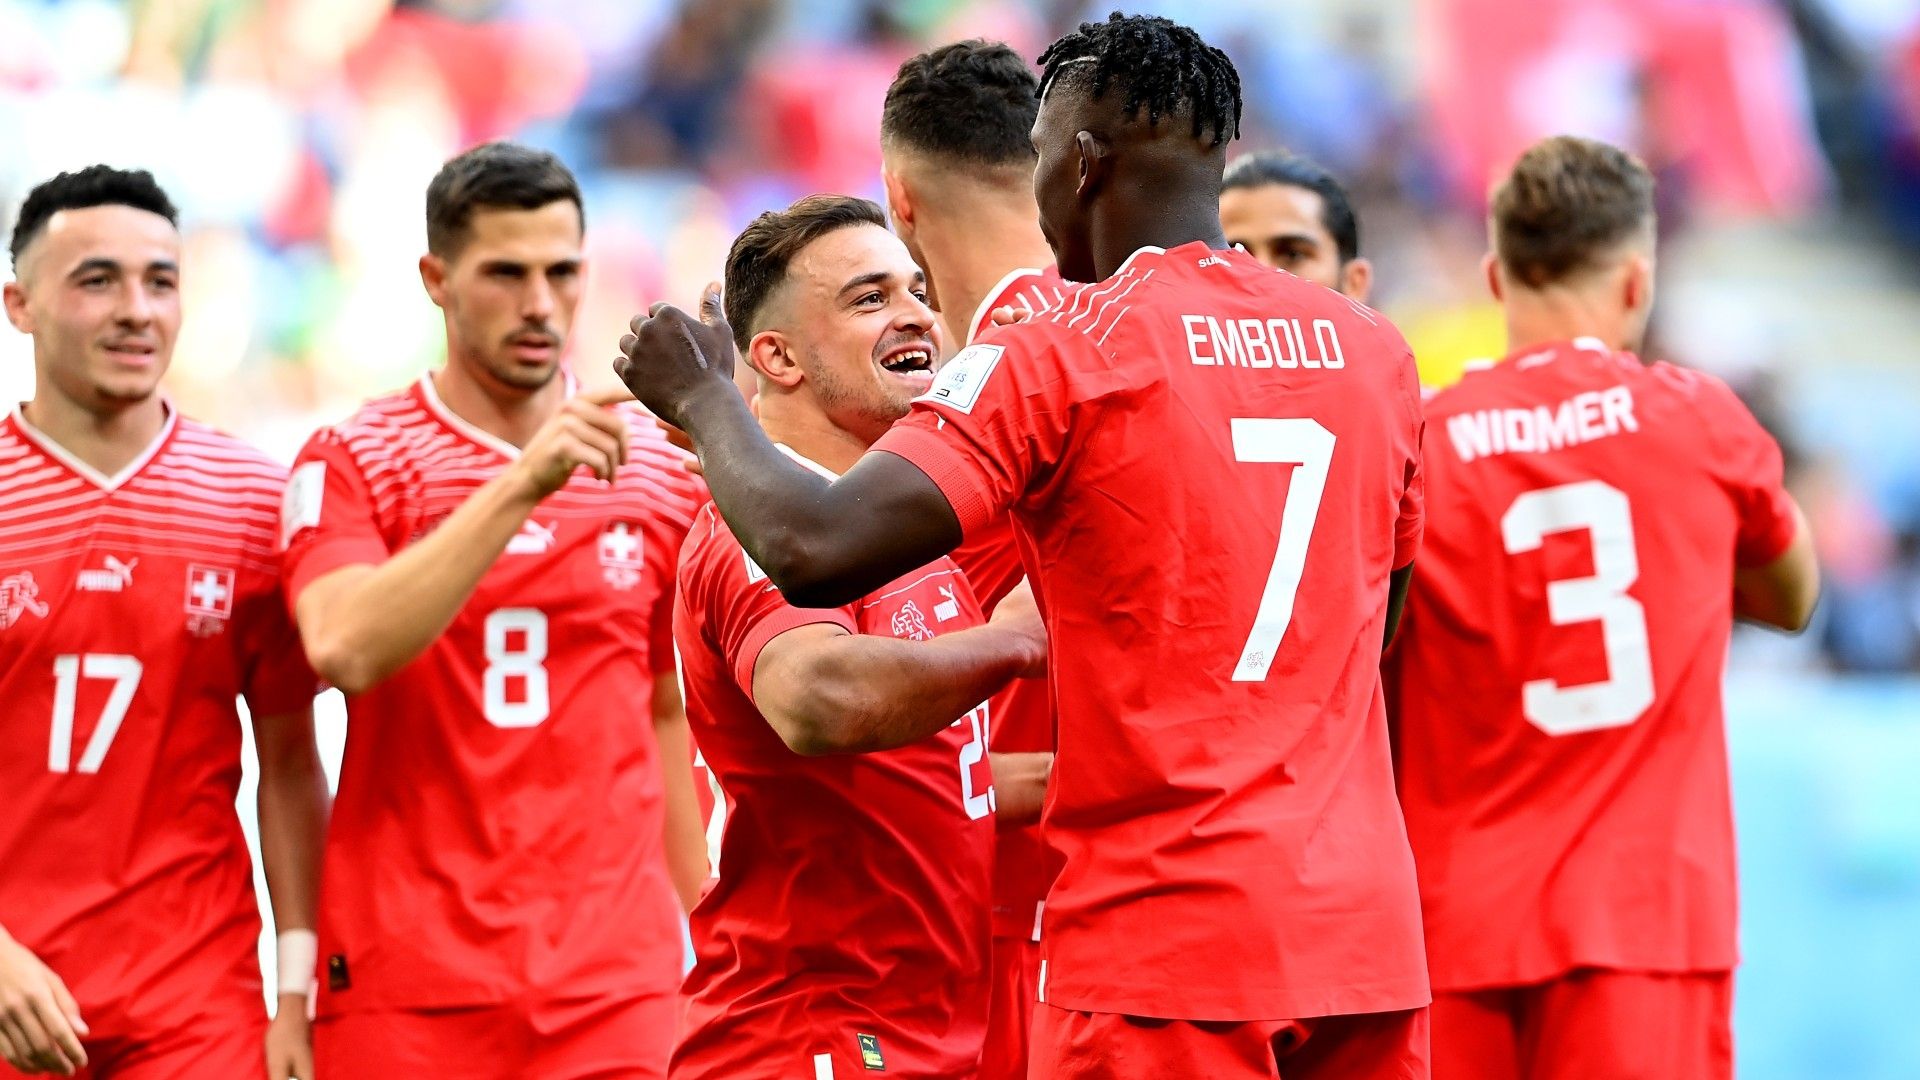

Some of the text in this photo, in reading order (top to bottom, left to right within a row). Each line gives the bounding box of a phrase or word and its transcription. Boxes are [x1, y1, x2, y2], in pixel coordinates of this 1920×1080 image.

[1180, 314, 1345, 369] EMBOLO
[1446, 384, 1638, 462] WIDMER
[1230, 417, 1337, 682] 7
[1501, 480, 1655, 735] 3
[48, 654, 142, 773] 17
[483, 609, 550, 728] 8
